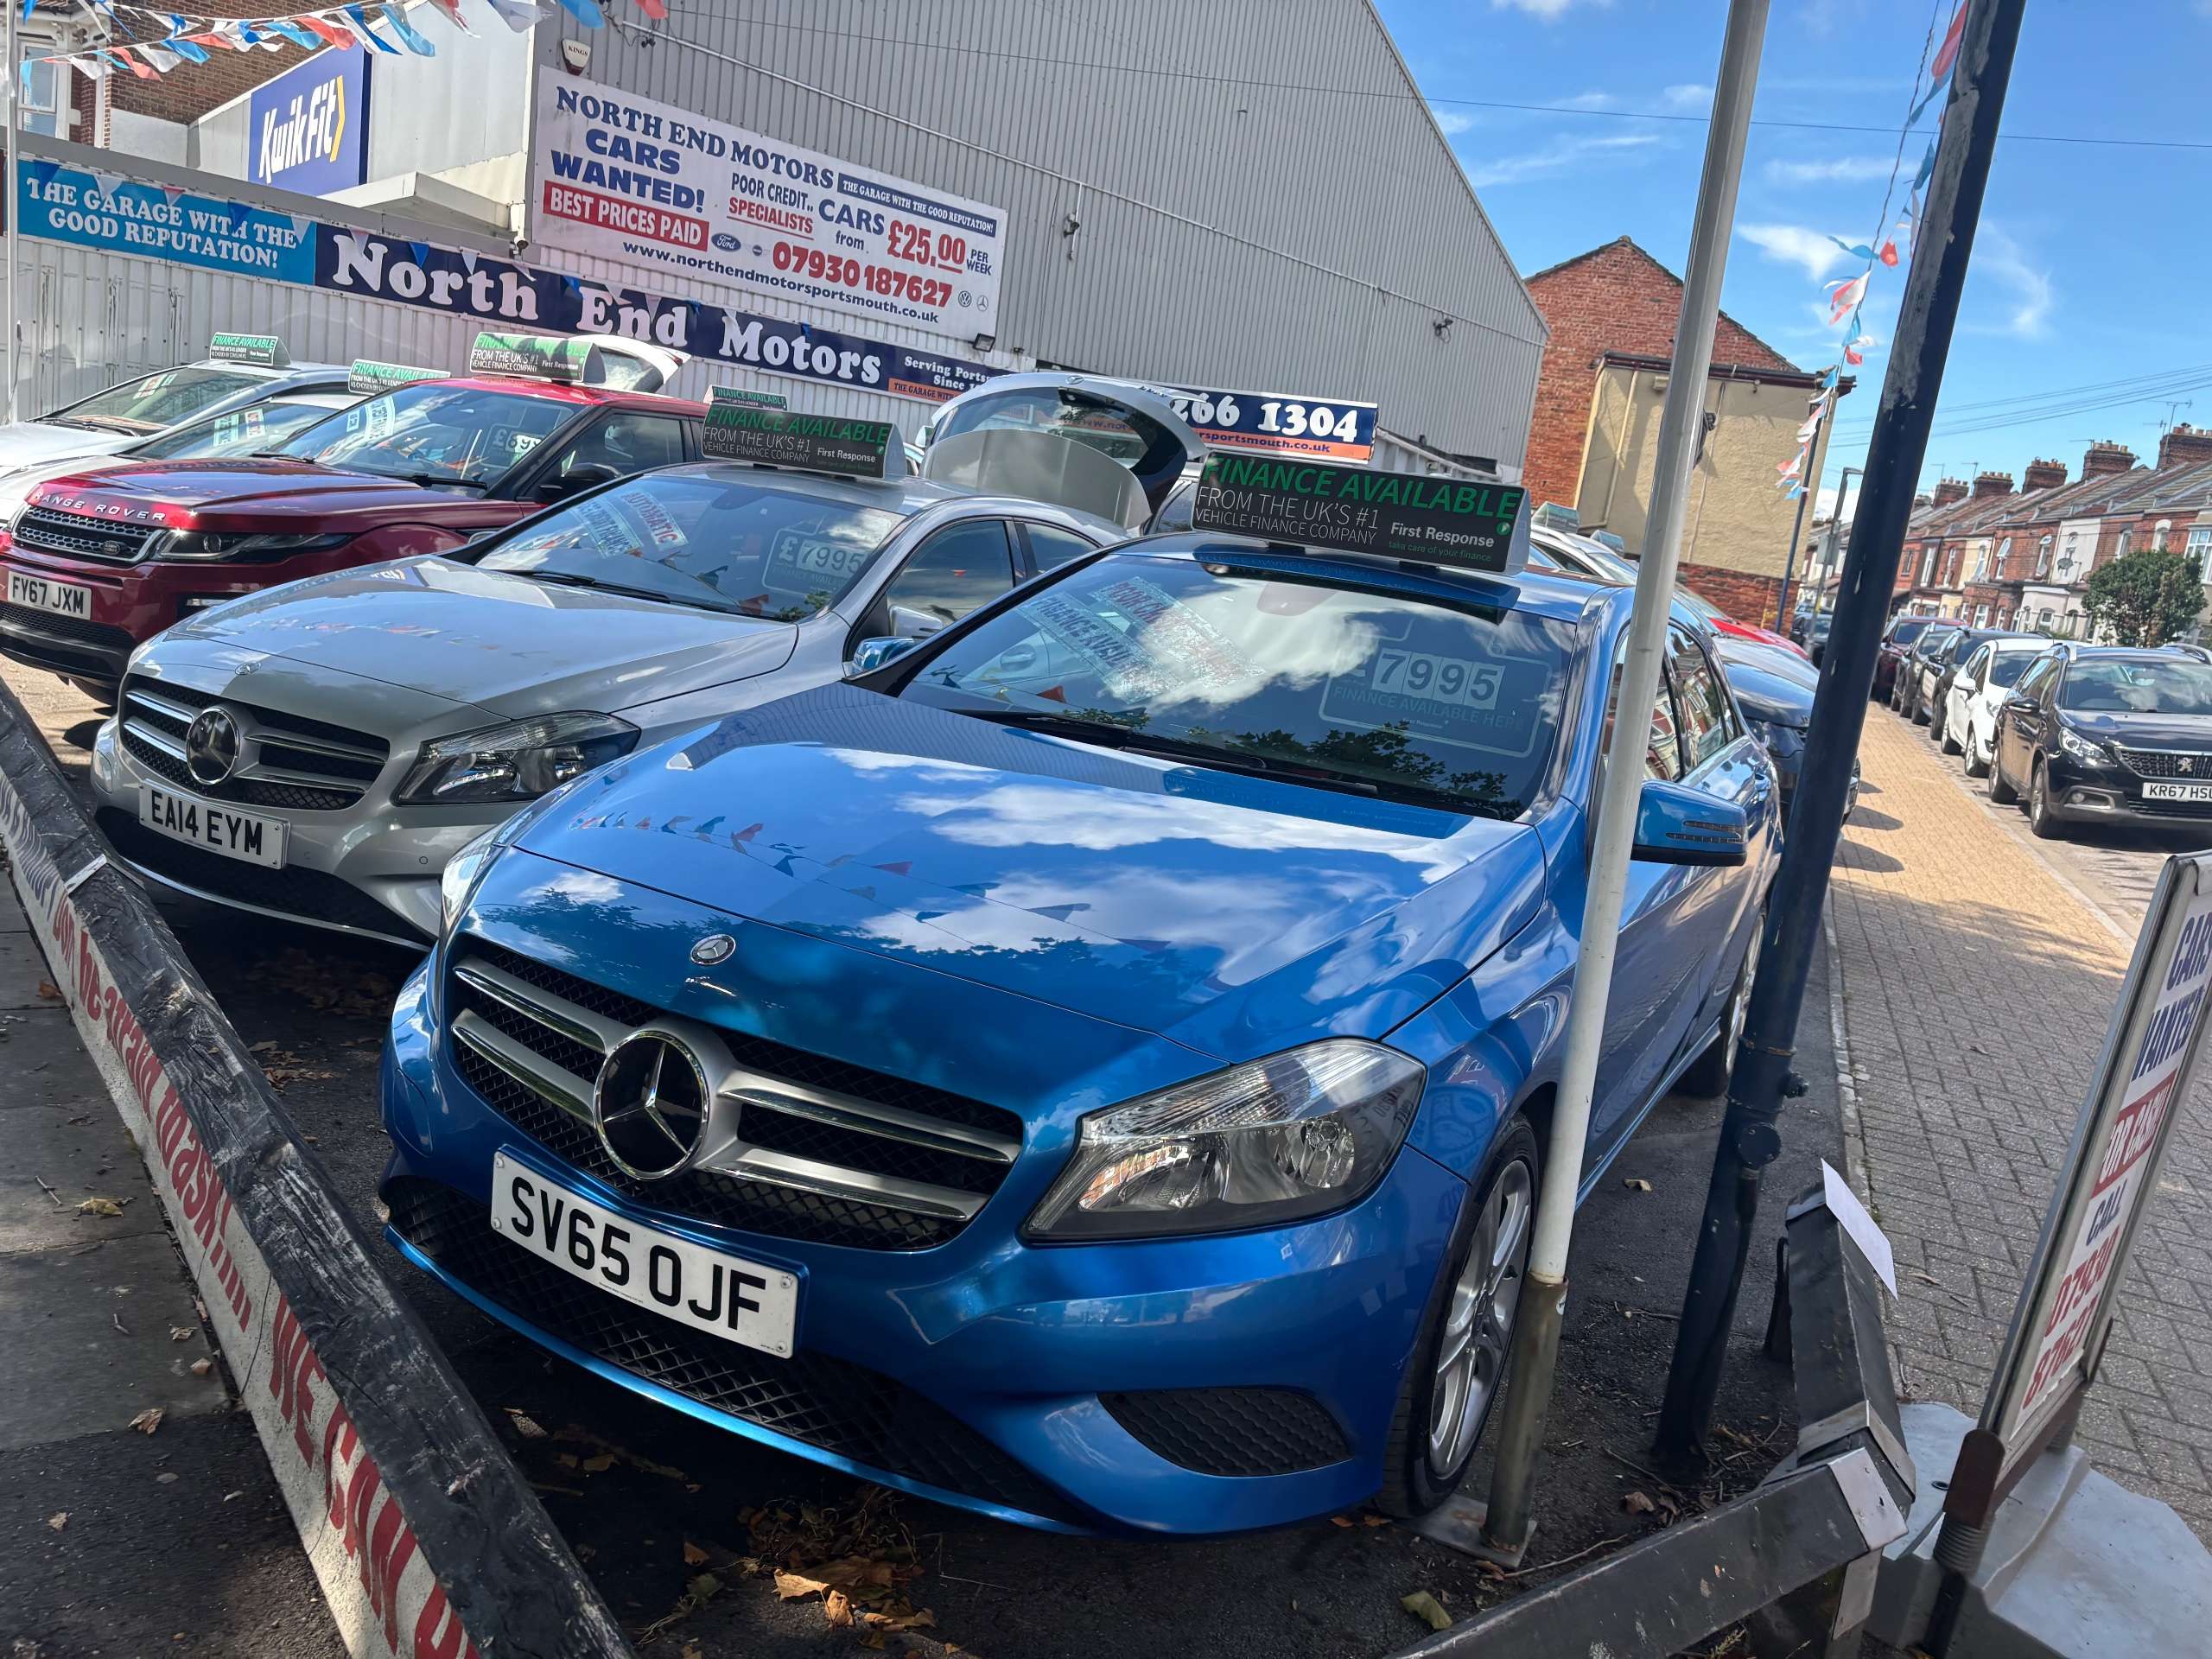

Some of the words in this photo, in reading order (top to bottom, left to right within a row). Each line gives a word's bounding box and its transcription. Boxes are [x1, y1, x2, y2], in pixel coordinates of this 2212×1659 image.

[556, 86, 663, 139] NORTH
[668, 119, 726, 158] END
[730, 140, 835, 189] MOTORS
[586, 128, 681, 175] CARS
[550, 149, 705, 213] WANTED!
[731, 172, 766, 200] POOR
[27, 177, 78, 206] THE
[84, 189, 183, 227] GARAGE
[188, 210, 249, 240] WITH
[253, 222, 298, 249] THE
[550, 186, 594, 218] BEST
[597, 199, 656, 236] PRICES
[659, 214, 702, 246] PAID
[728, 196, 813, 235] SPECIALISTS
[818, 198, 885, 236] CARS
[842, 180, 858, 194] THE
[859, 183, 892, 202] GARAGE
[892, 194, 912, 207] WITH
[912, 200, 927, 213] THE
[927, 203, 949, 219] GOOD
[948, 211, 995, 233] REPUTATION!
[48, 207, 119, 238] GOOD
[124, 220, 279, 269] REPUTATION!
[836, 229, 865, 251] from
[887, 219, 966, 266] £25.00
[970, 248, 989, 263] PER
[622, 241, 939, 324] www.northendmotorsportsmouth.co.uk
[772, 240, 861, 287] 07930
[862, 264, 953, 308] 187627
[965, 258, 993, 276] WEEK
[332, 234, 539, 321] North
[576, 285, 688, 347] End
[719, 315, 881, 385] Motors
[212, 335, 239, 346] FINANCE
[239, 337, 275, 349] AVAILABLE
[473, 349, 493, 361] FROM
[494, 351, 509, 362] THE
[512, 352, 529, 364] UK'S
[352, 363, 394, 379] FINANCE
[904, 356, 951, 377] Serving
[933, 374, 965, 391] Since
[893, 382, 907, 393] THE
[908, 385, 936, 398] GARAGE
[703, 426, 735, 442] FROM
[741, 430, 764, 446] THE
[766, 433, 795, 450] UK'S
[797, 438, 810, 453] #1
[706, 405, 785, 432] FINANCE
[786, 416, 893, 445] AVAILABLE
[1258, 401, 1357, 442] 1304
[702, 441, 734, 454] VEHICLE
[736, 444, 769, 458] FINANCE
[770, 448, 810, 464] COMPANY
[817, 447, 836, 458] First
[836, 449, 876, 463] Response
[34, 491, 86, 509] RANGE
[94, 503, 166, 521] ROVER
[1197, 485, 1254, 513] FROM
[1258, 493, 1300, 518] THE
[1303, 499, 1351, 526] UK'S
[1355, 507, 1380, 529] #1
[1203, 455, 1337, 497] FINANCE
[1338, 473, 1525, 520] AVAILABLE
[1196, 507, 1248, 528] VEHICLE
[1249, 514, 1307, 536] FINANCE
[1309, 521, 1377, 546] COMPANY
[1390, 522, 1422, 540] First
[1424, 525, 1495, 550] Response
[12, 575, 48, 606] FY67
[52, 588, 85, 614] JXM
[1333, 686, 1397, 709] FINANCE
[1399, 696, 1480, 724] AVAILABLE
[2149, 785, 2187, 798] KR67
[151, 790, 200, 838] EA14
[207, 809, 263, 856] EYM
[511, 1176, 632, 1287] SV65
[648, 1244, 767, 1332] OJF
